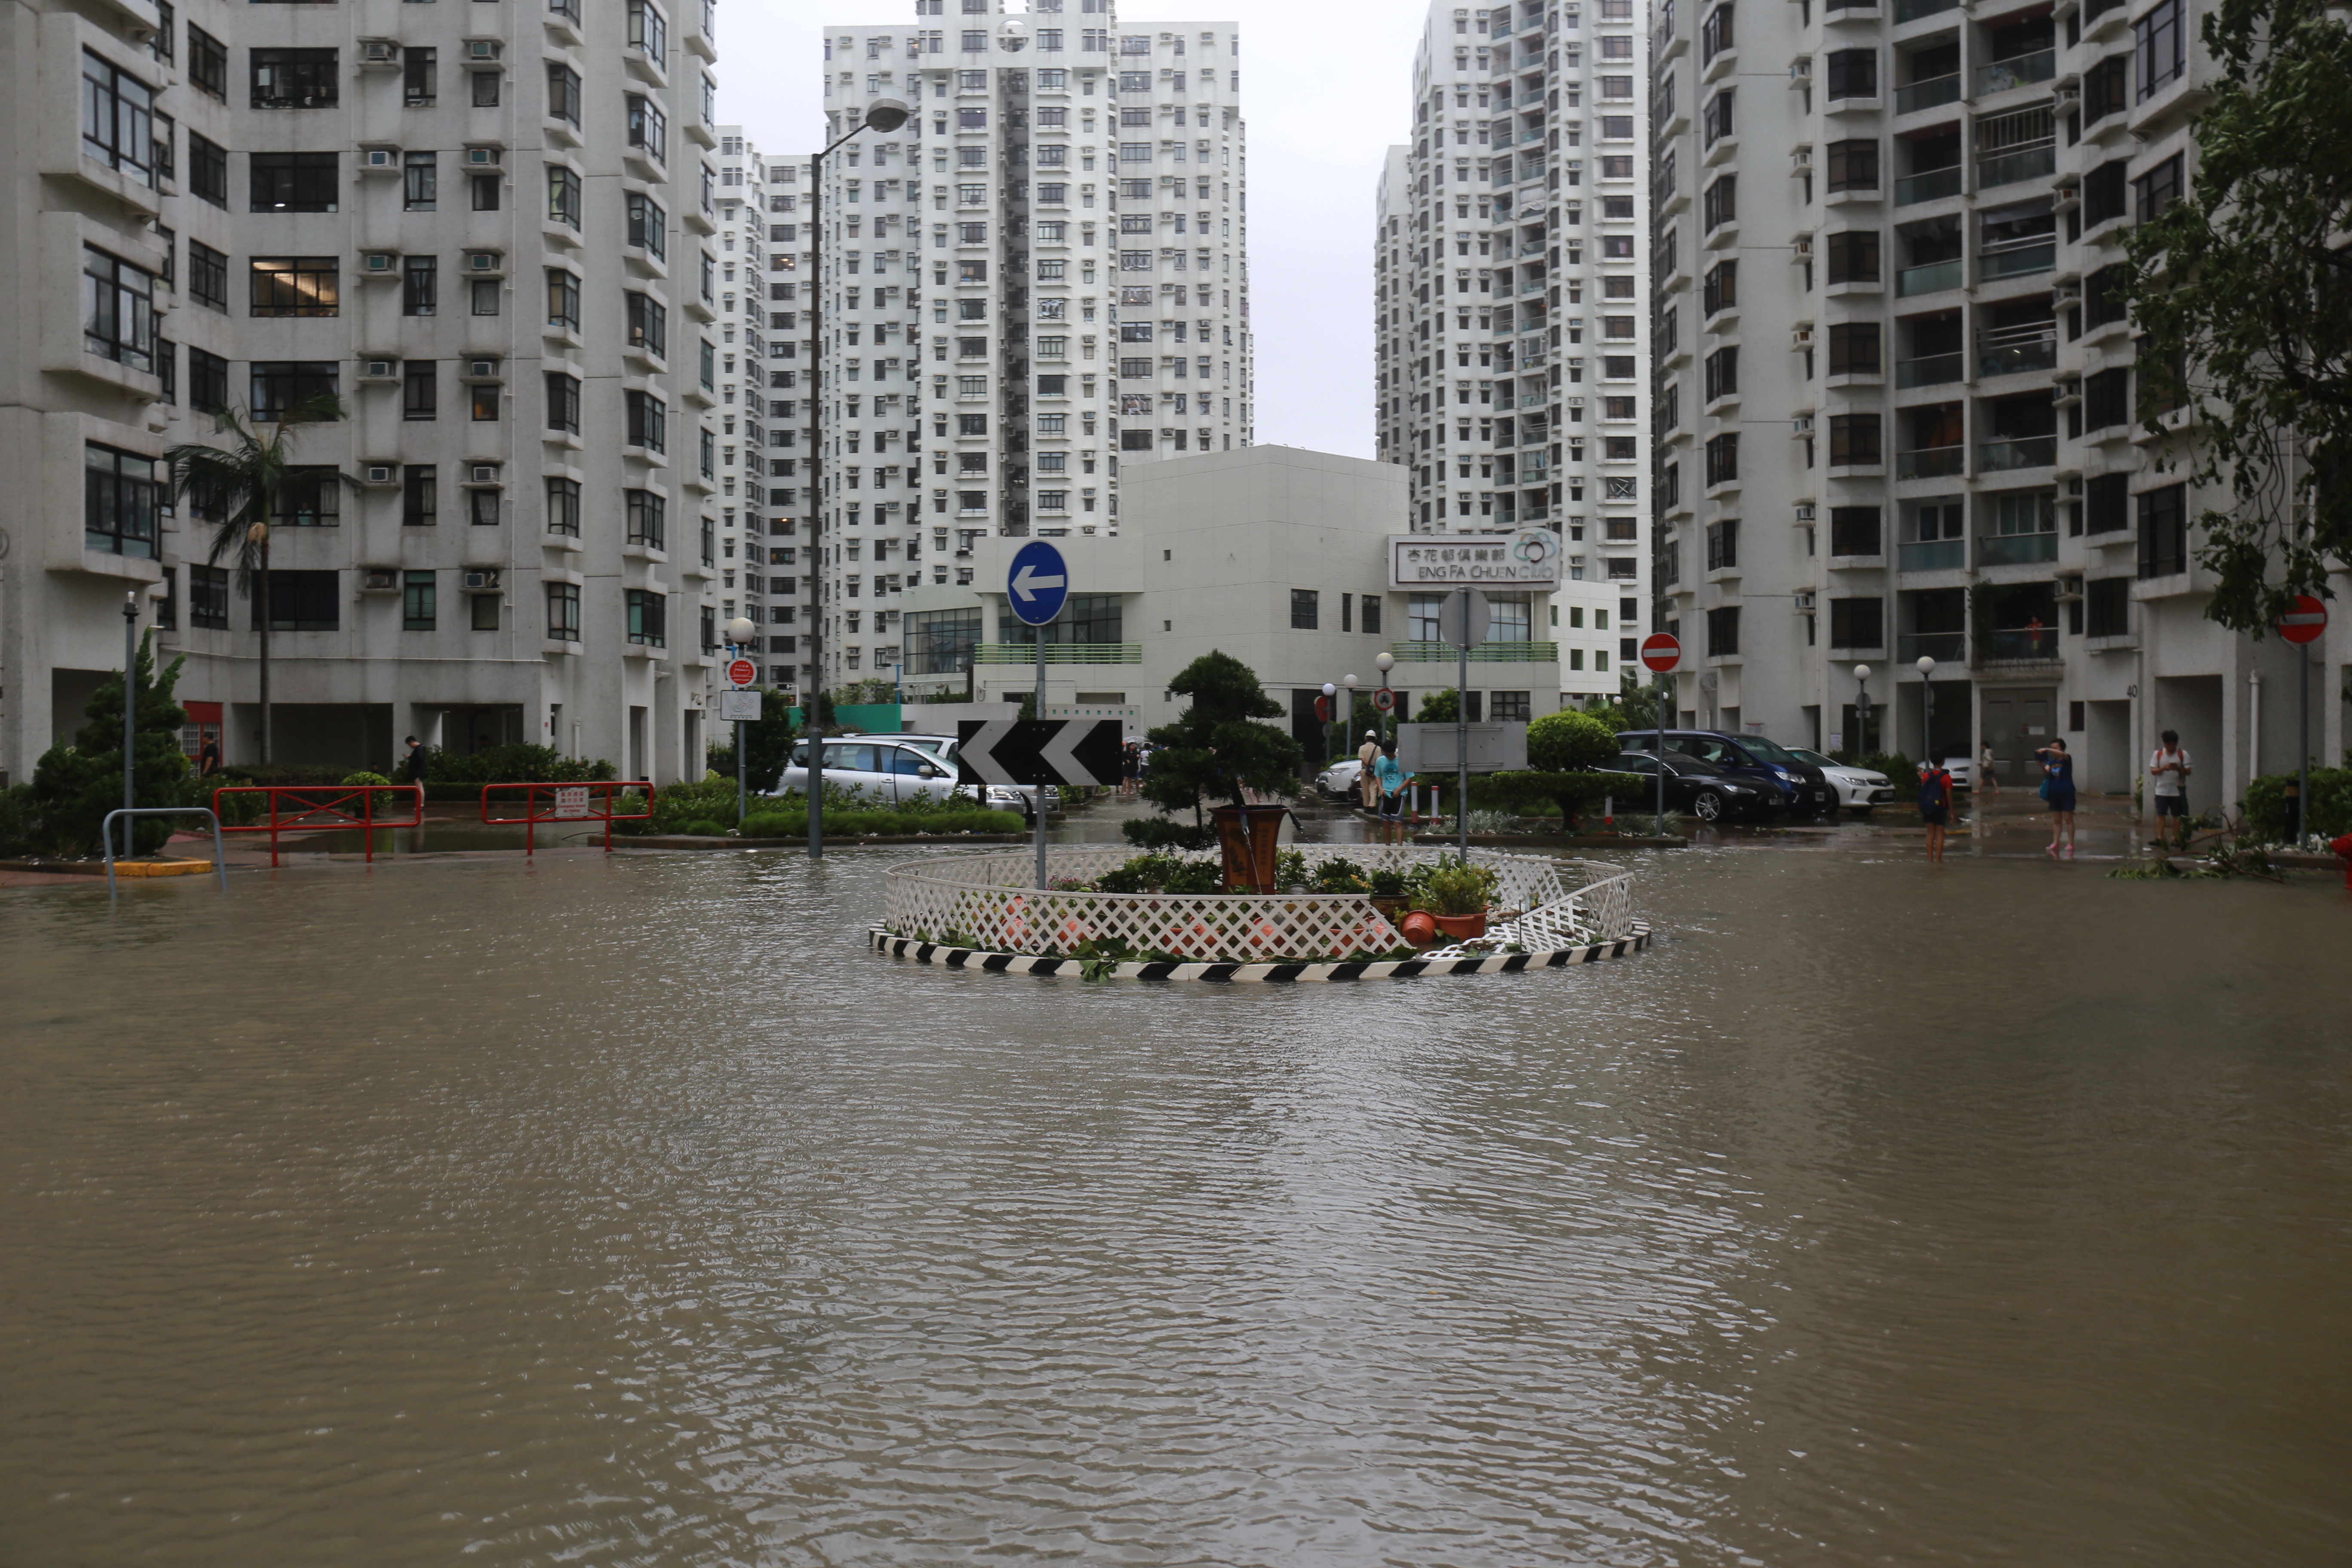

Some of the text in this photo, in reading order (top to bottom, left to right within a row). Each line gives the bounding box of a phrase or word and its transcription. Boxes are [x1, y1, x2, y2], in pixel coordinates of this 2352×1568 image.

[1408, 548, 1505, 562] 杏花邨俱樂部
[1450, 564, 1466, 577] FA
[1470, 565, 1516, 578] CHUEN
[2127, 684, 2137, 698] 40
[701, 709, 706, 720] 38
